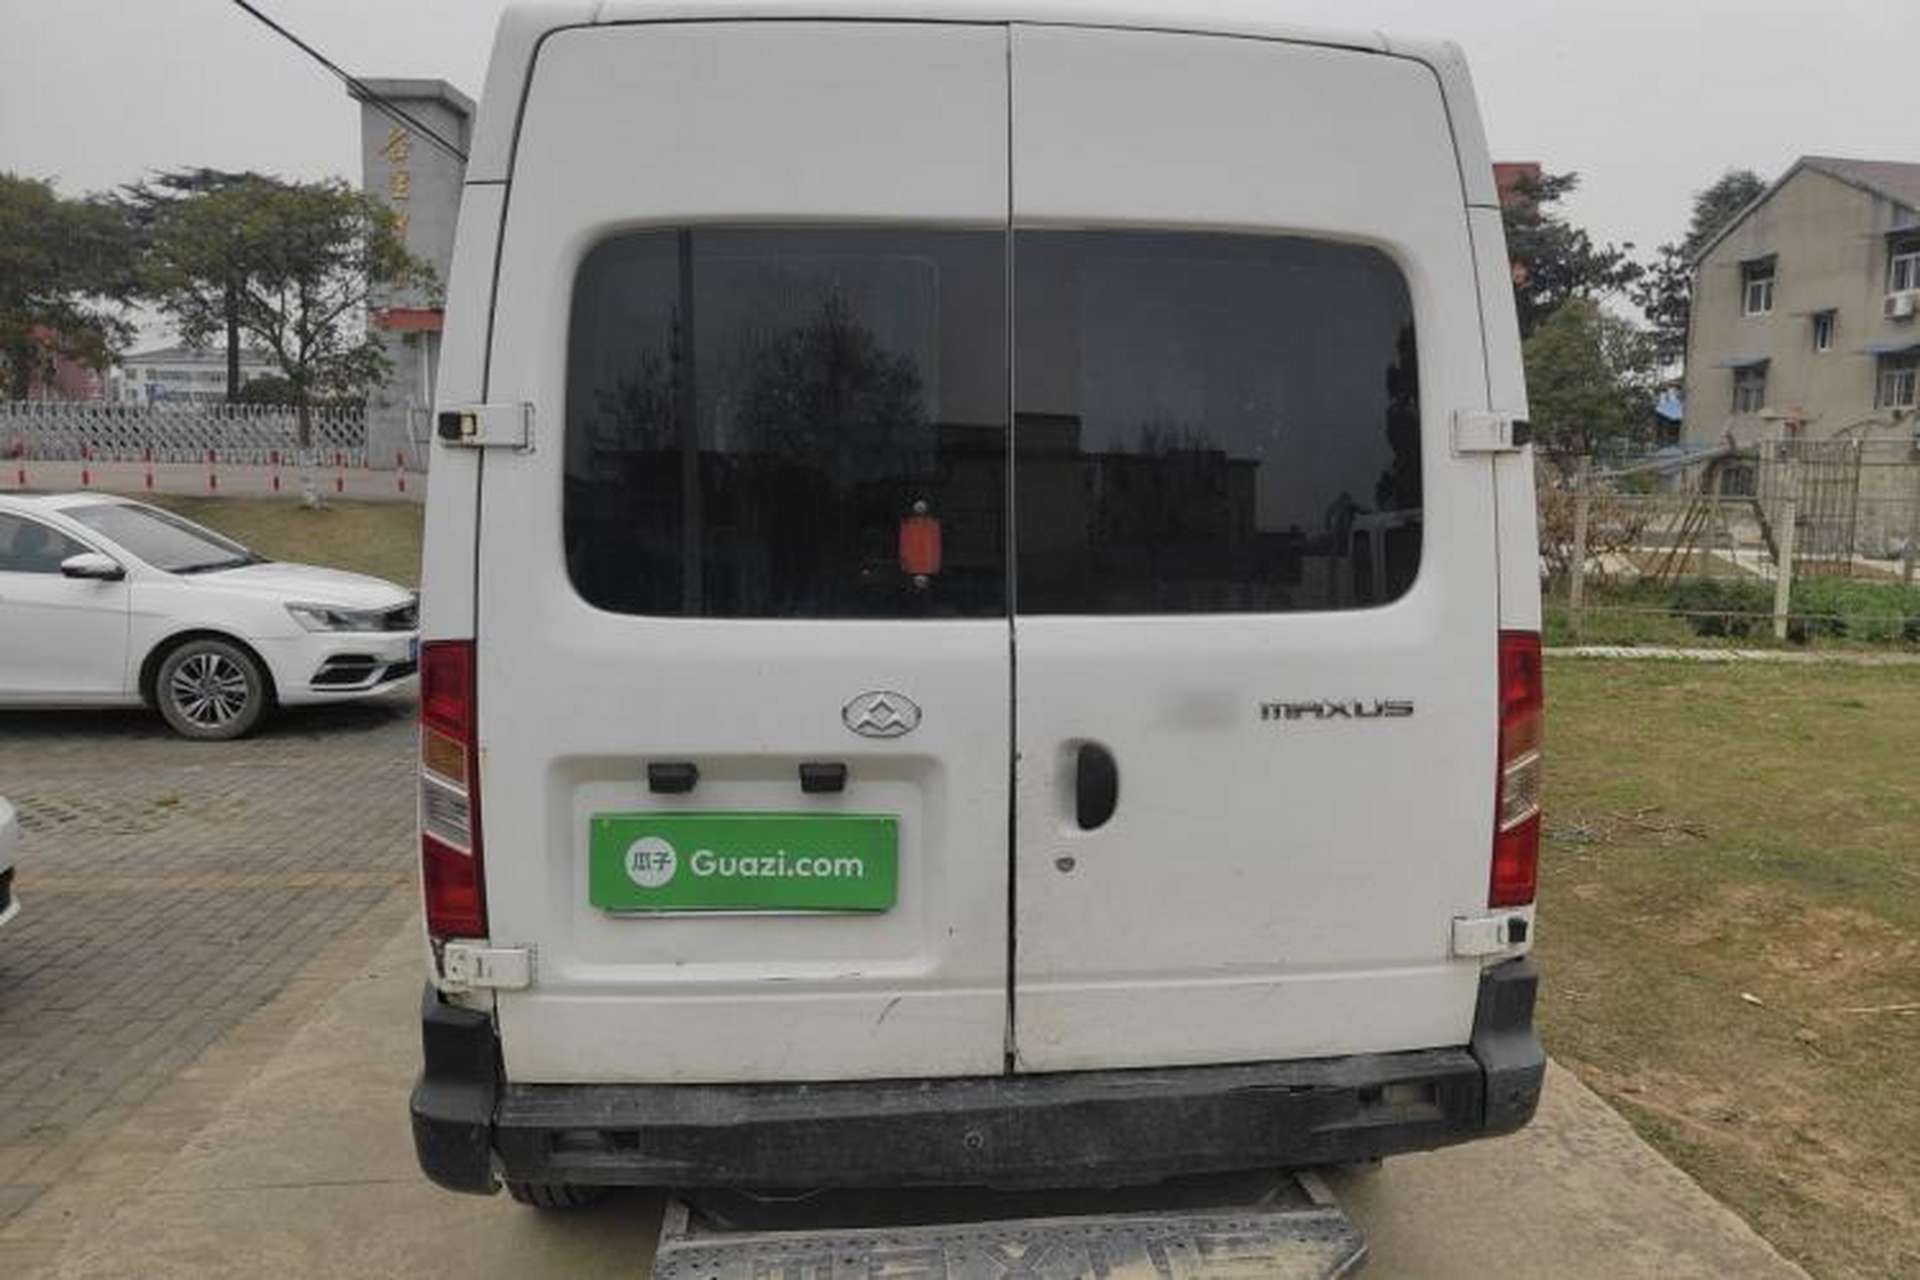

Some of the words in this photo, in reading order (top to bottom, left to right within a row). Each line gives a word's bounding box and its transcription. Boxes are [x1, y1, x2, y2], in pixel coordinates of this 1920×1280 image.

[1260, 701, 1414, 719] MAXUS
[631, 850, 672, 872] 瓜子
[690, 849, 865, 878] Guazi.com
